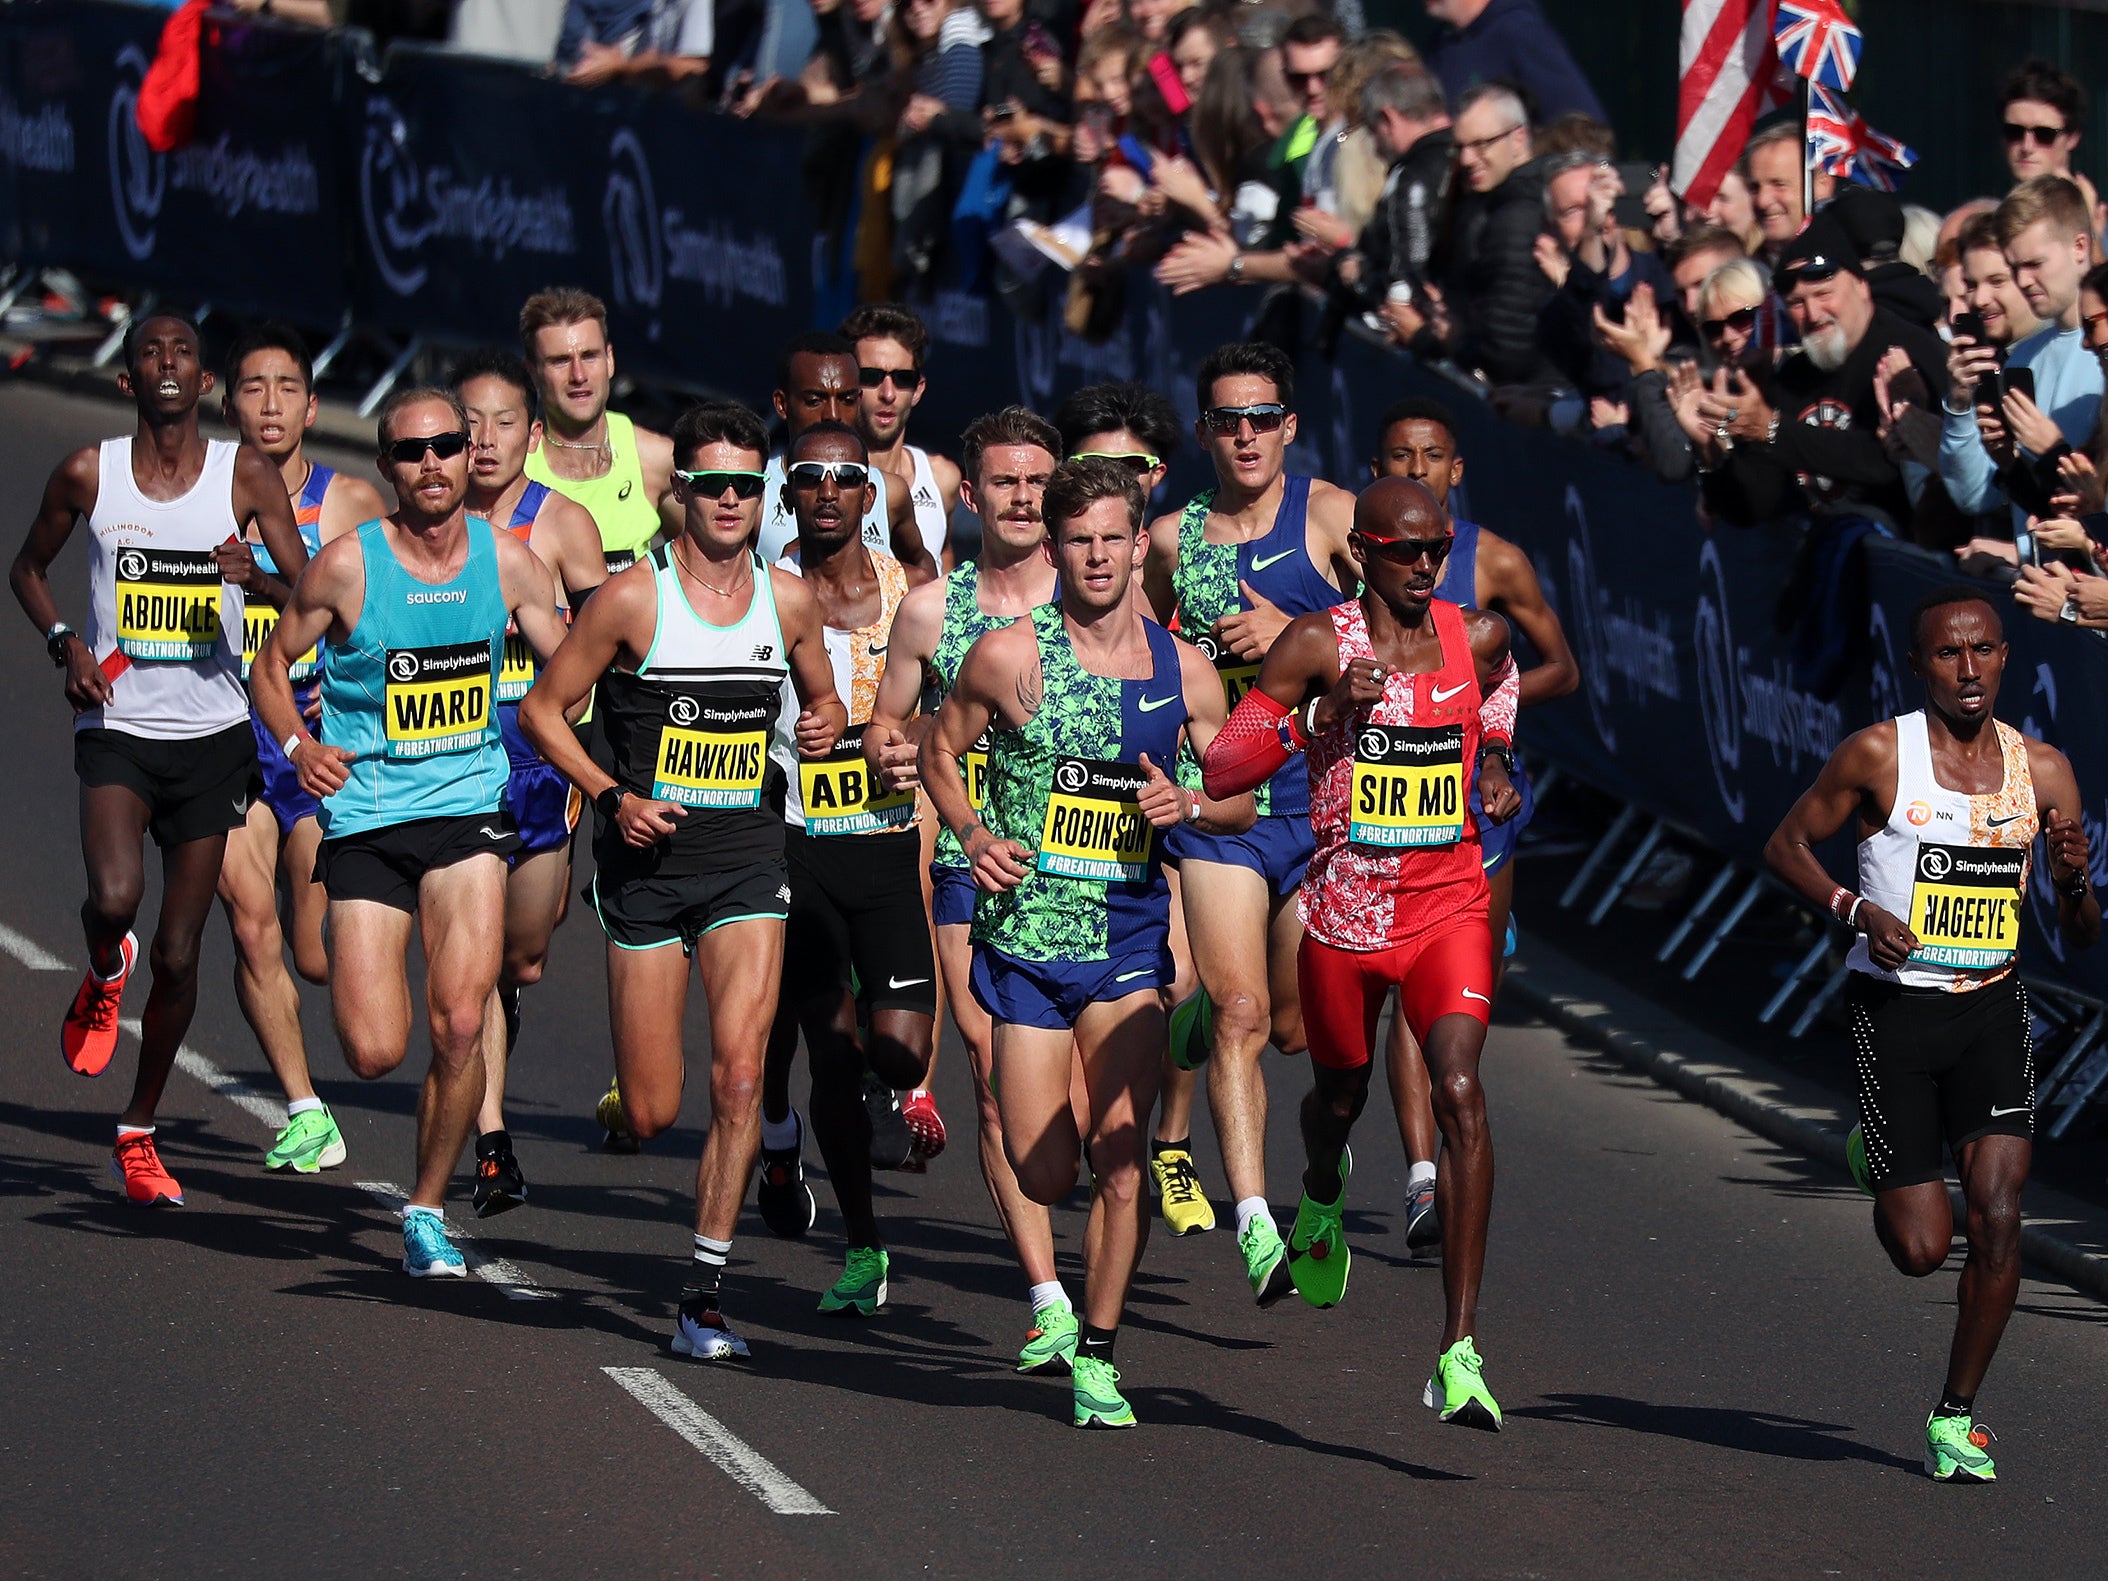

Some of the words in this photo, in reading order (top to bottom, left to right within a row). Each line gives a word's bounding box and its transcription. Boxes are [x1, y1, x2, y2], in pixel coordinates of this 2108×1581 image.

[406, 589, 468, 605] saucony
[123, 594, 215, 631] ABDULLE
[124, 641, 211, 658] #GREATNORTHRUN
[423, 653, 490, 670] Simplyhealth
[394, 686, 484, 731] WARD
[703, 707, 767, 723] Simplyhealth
[395, 732, 482, 756] #GREATNORTHRUN
[1394, 739, 1461, 755] Simplyhealth
[664, 738, 760, 780] HAWKINS
[811, 771, 905, 808] ABD
[1092, 774, 1150, 791] Simplyhea
[660, 785, 755, 805] #GREATNORTHRUN
[1360, 775, 1407, 816] SIR
[1418, 775, 1457, 816] MO
[1936, 811, 1954, 821] NN
[1051, 805, 1148, 853] ROBINSON
[1358, 825, 1456, 844] #GREATNORTHRUN
[1046, 855, 1142, 879] #GREATNORTHRUN
[1956, 860, 2021, 875] Simplyhealth
[1923, 894, 2007, 940] NAGEEYE
